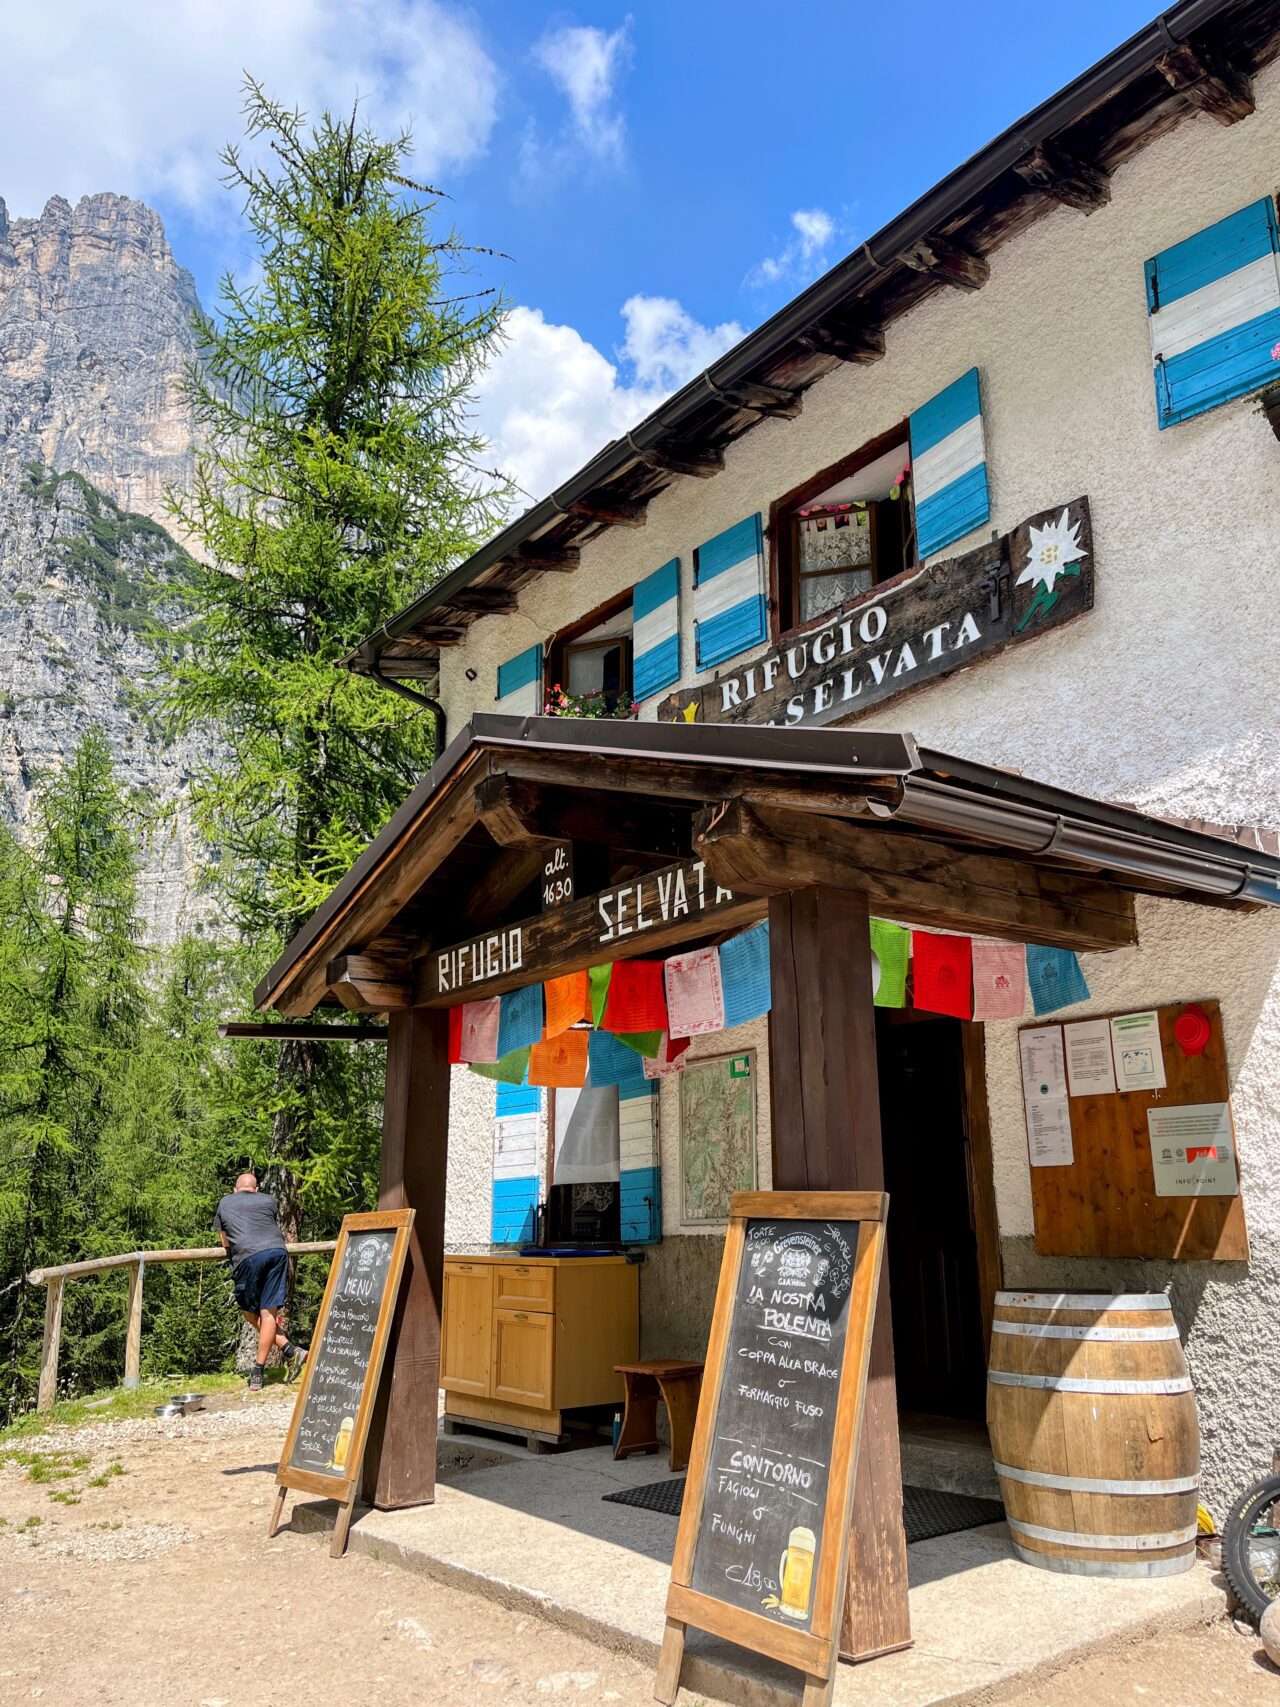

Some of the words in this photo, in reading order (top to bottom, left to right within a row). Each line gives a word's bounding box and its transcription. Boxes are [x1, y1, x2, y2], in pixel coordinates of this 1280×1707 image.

[720, 606, 887, 712] RIFUGIO
[785, 612, 982, 726] SELVATA
[545, 848, 569, 875] alt.
[543, 877, 572, 904] 1630
[438, 927, 522, 992] RIFUGIO
[773, 1234, 822, 1256] Grevensteiner
[770, 1289, 826, 1312] NOSTRA
[763, 1307, 832, 1337] POLENTA
[738, 1348, 776, 1365] COPPA
[804, 1360, 838, 1379] BRACE
[795, 1400, 823, 1417] FUSO
[730, 1451, 812, 1488] CONTORNO
